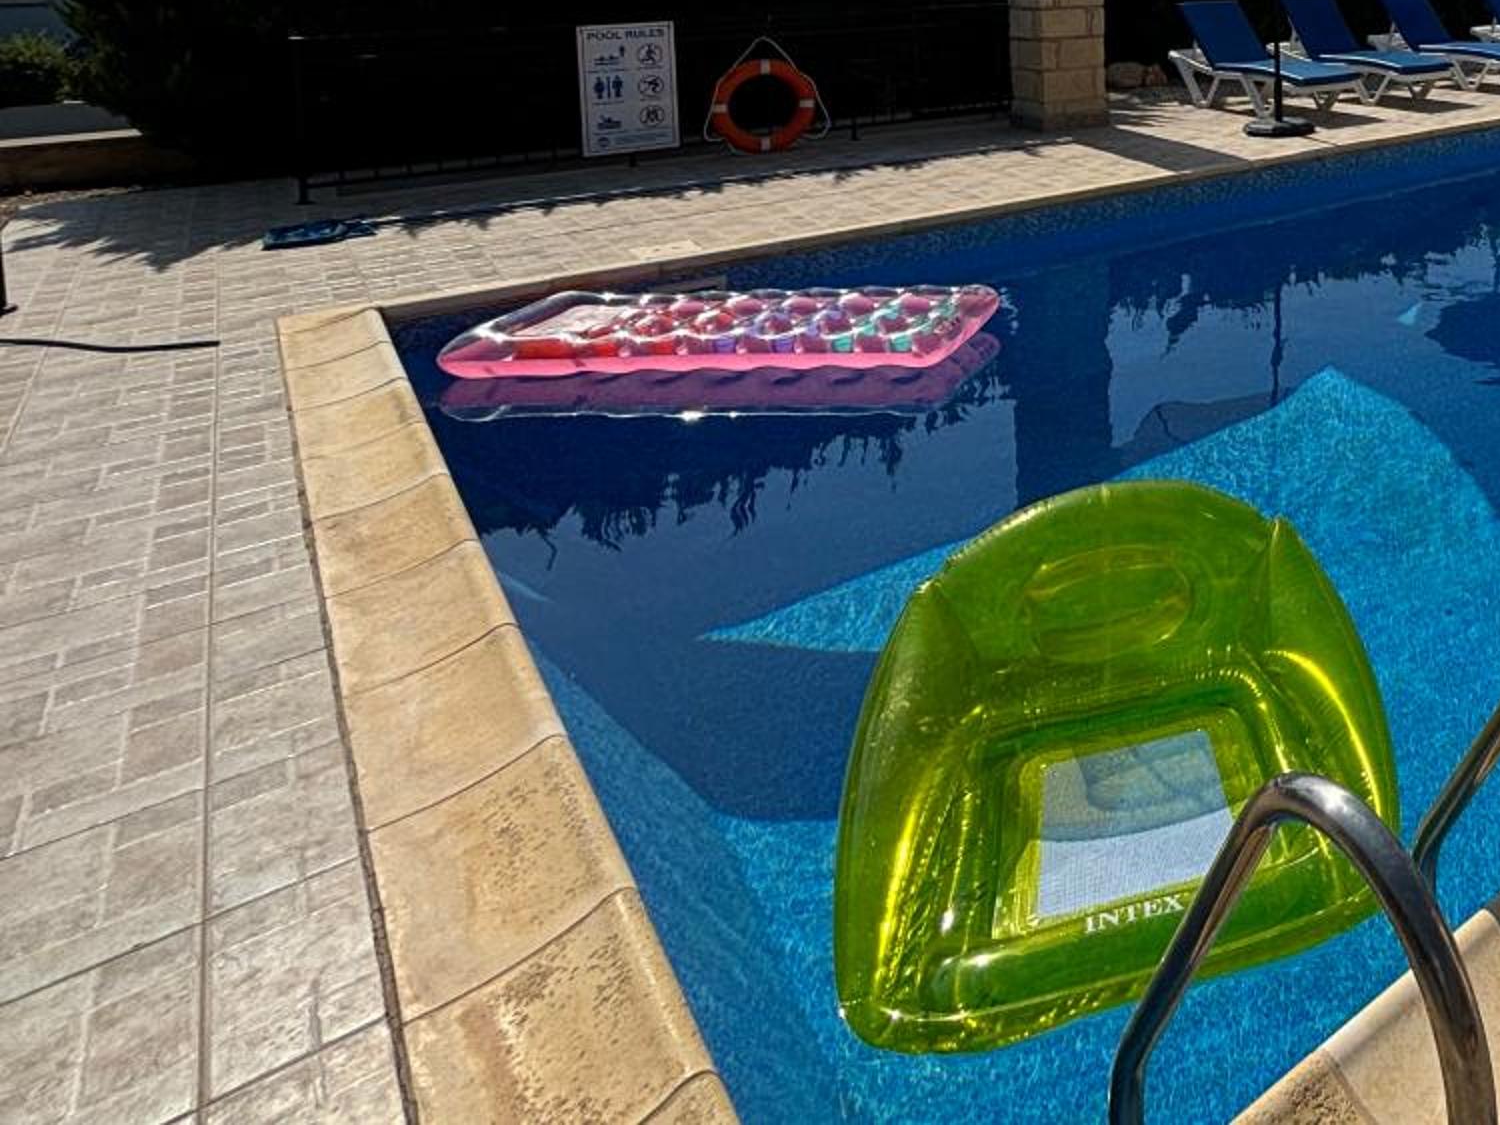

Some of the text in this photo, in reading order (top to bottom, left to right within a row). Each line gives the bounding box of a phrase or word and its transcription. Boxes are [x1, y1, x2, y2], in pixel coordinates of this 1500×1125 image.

[586, 28, 664, 40] POOL RULES
[1085, 893, 1185, 934] INTEX
